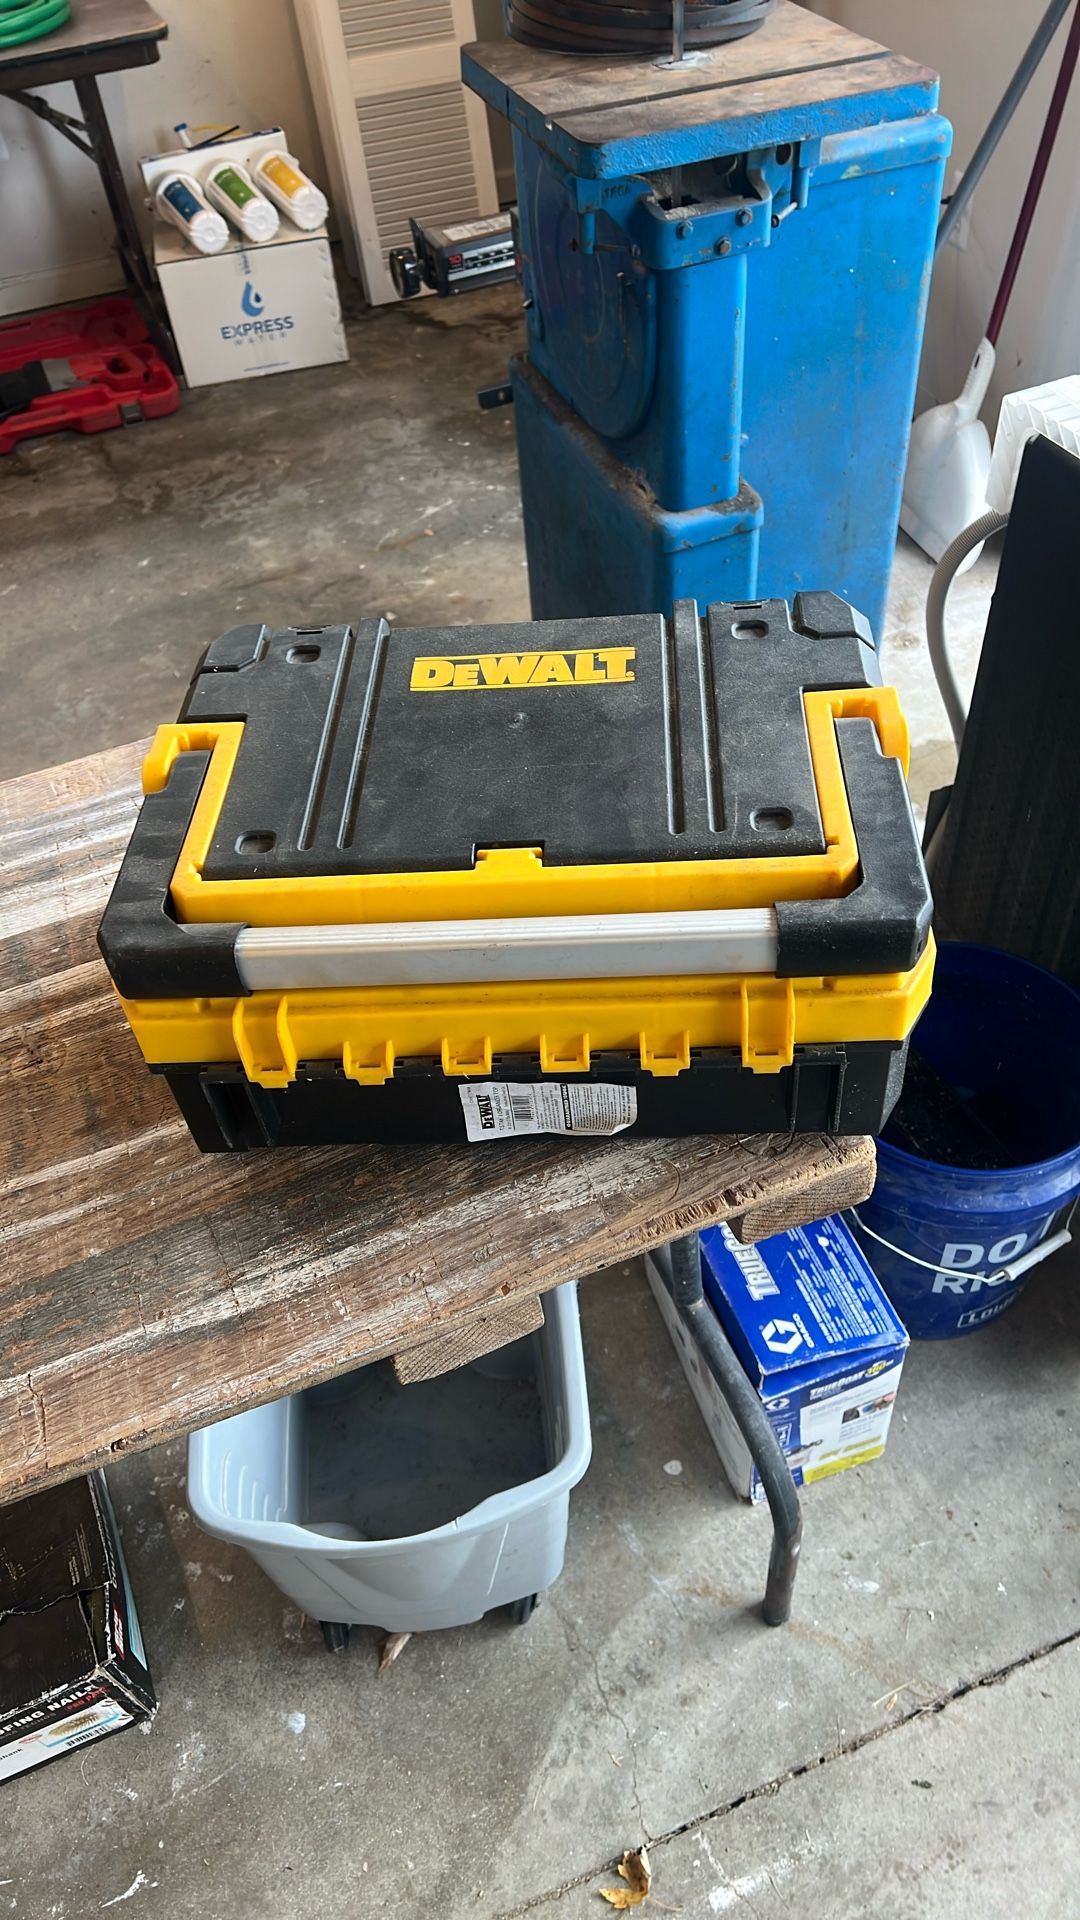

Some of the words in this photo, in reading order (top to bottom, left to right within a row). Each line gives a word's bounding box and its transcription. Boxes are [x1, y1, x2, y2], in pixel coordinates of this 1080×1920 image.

[219, 315, 294, 340] EXPRESS
[940, 1233, 1028, 1268] DO
[792, 1313, 815, 1349] GRACO
